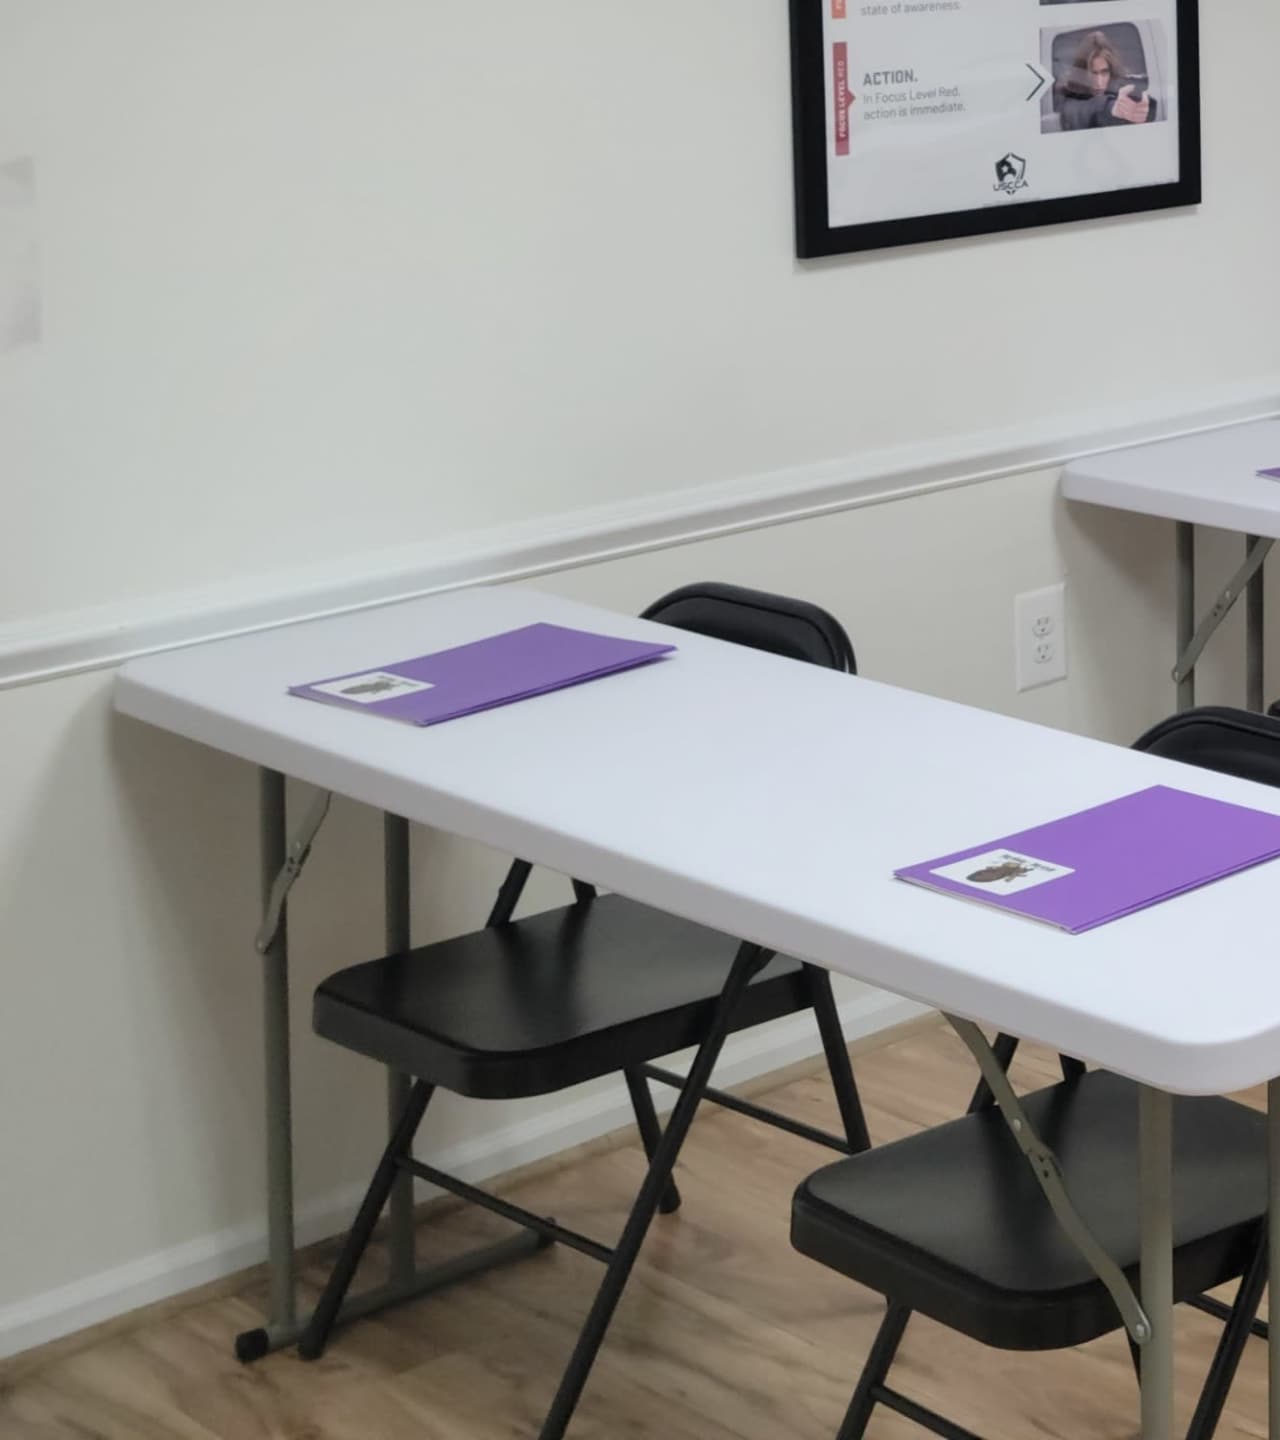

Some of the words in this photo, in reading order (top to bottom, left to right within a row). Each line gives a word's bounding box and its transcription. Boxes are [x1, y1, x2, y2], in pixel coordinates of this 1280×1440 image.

[861, 4, 888, 16] state
[890, 3, 902, 14] of
[863, 69, 918, 86] ACTION.
[863, 95, 872, 104] In
[875, 92, 907, 103] Focus
[909, 89, 936, 101] Level
[864, 109, 897, 120] action
[899, 107, 908, 117] is
[910, 102, 966, 116] immediate.
[993, 180, 1029, 192] USCCA
